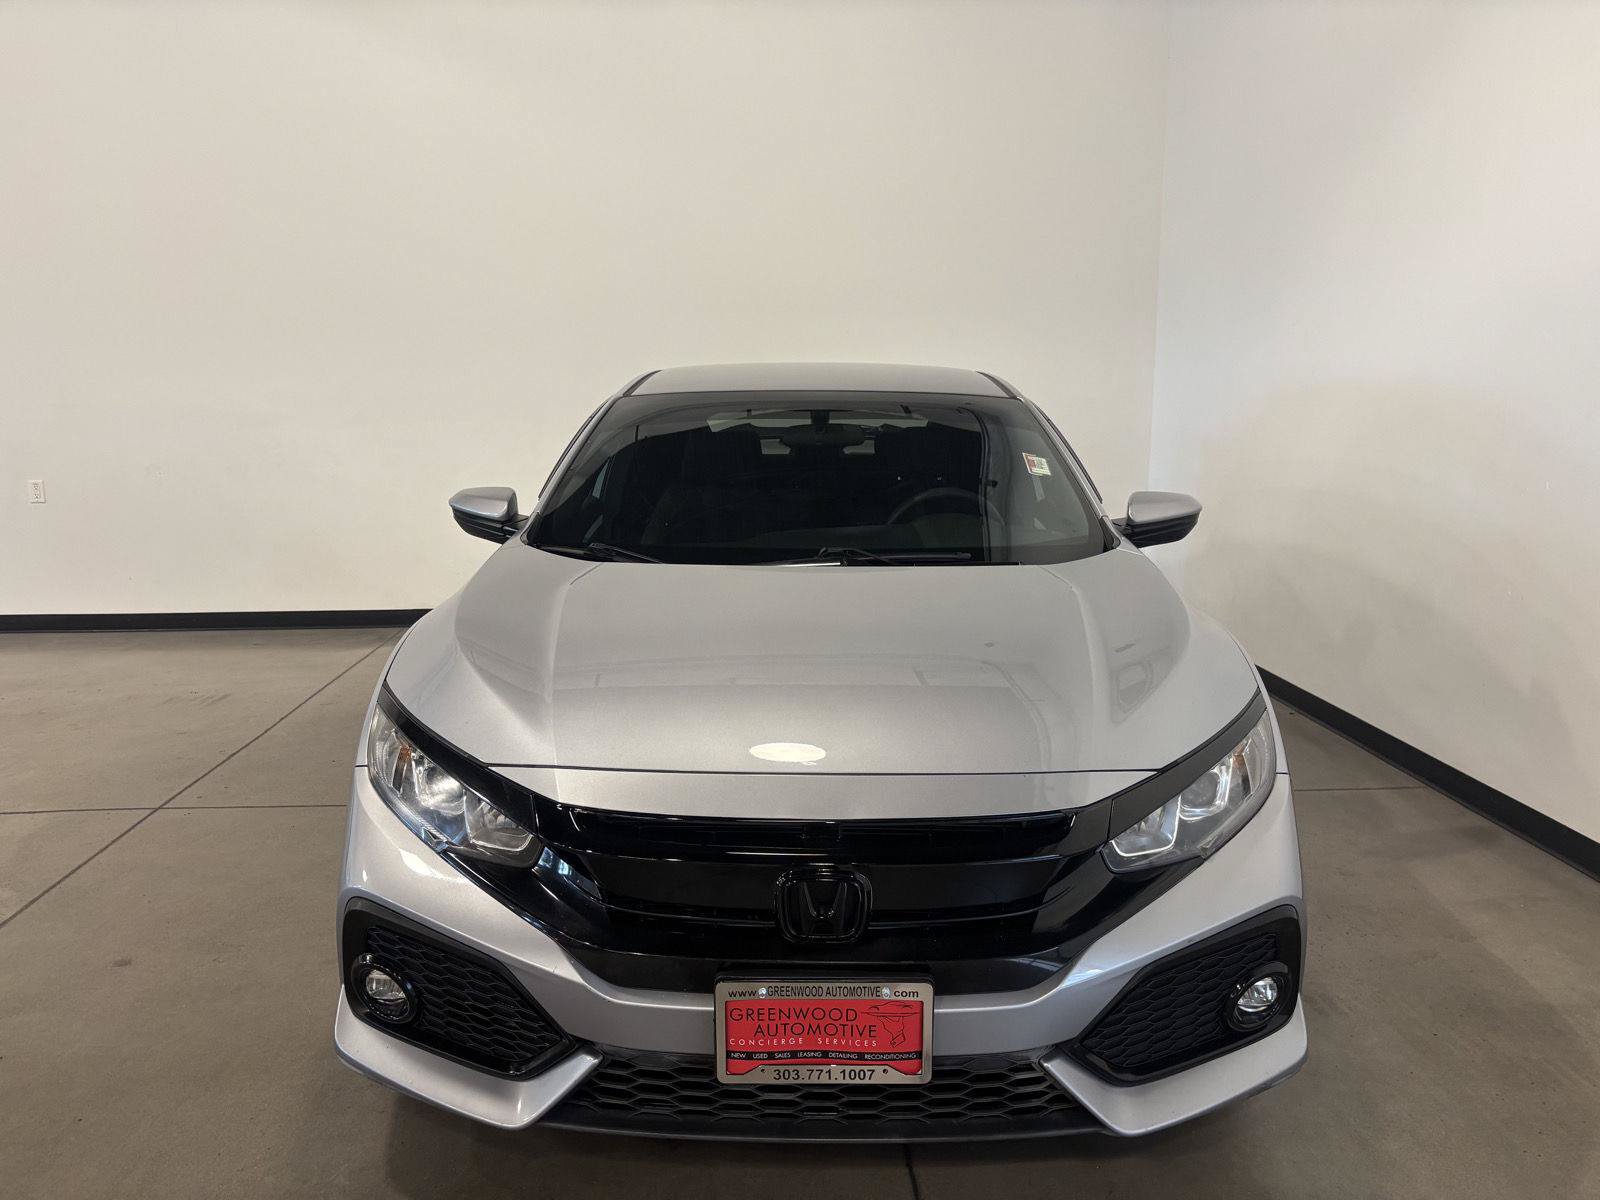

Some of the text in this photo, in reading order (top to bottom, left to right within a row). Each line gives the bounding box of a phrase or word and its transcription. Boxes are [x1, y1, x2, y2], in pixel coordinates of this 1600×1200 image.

[728, 986, 918, 998] www GREENWOOD AUTOMOTIVE com
[730, 1008, 857, 1022] GREENWOOD
[754, 1023, 877, 1038] AUTOMOTIVE
[730, 1038, 877, 1047] CONCIERGE SERVICES
[773, 1069, 875, 1081] 303.771.1007
